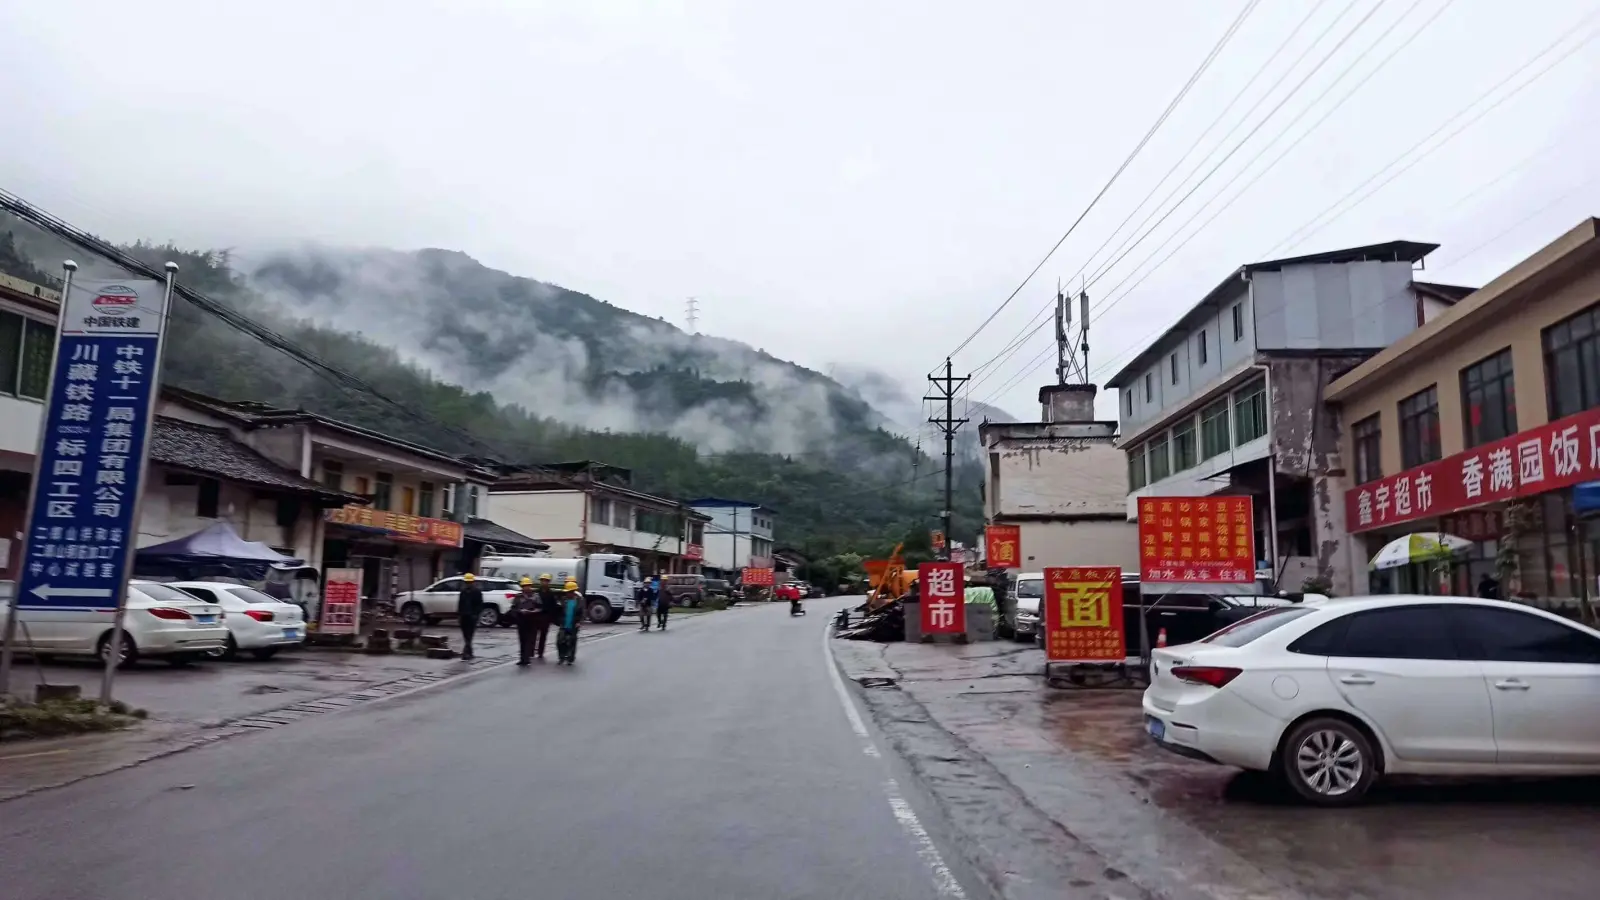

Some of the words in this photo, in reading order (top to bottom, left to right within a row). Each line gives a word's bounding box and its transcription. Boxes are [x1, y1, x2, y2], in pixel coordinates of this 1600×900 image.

[84, 316, 140, 328] 中国铁建
[60, 344, 99, 421] 川藏铁路
[92, 344, 144, 518] 中铁十一局集团有限公司
[47, 439, 87, 518] 标四工区
[1358, 470, 1433, 526] 鑫宇超市
[928, 568, 956, 629] 超市
[1148, 569, 1176, 580] 加水
[1184, 569, 1210, 580] 洗车
[1219, 569, 1247, 580] 住宿
[1054, 581, 1113, 628] 面
